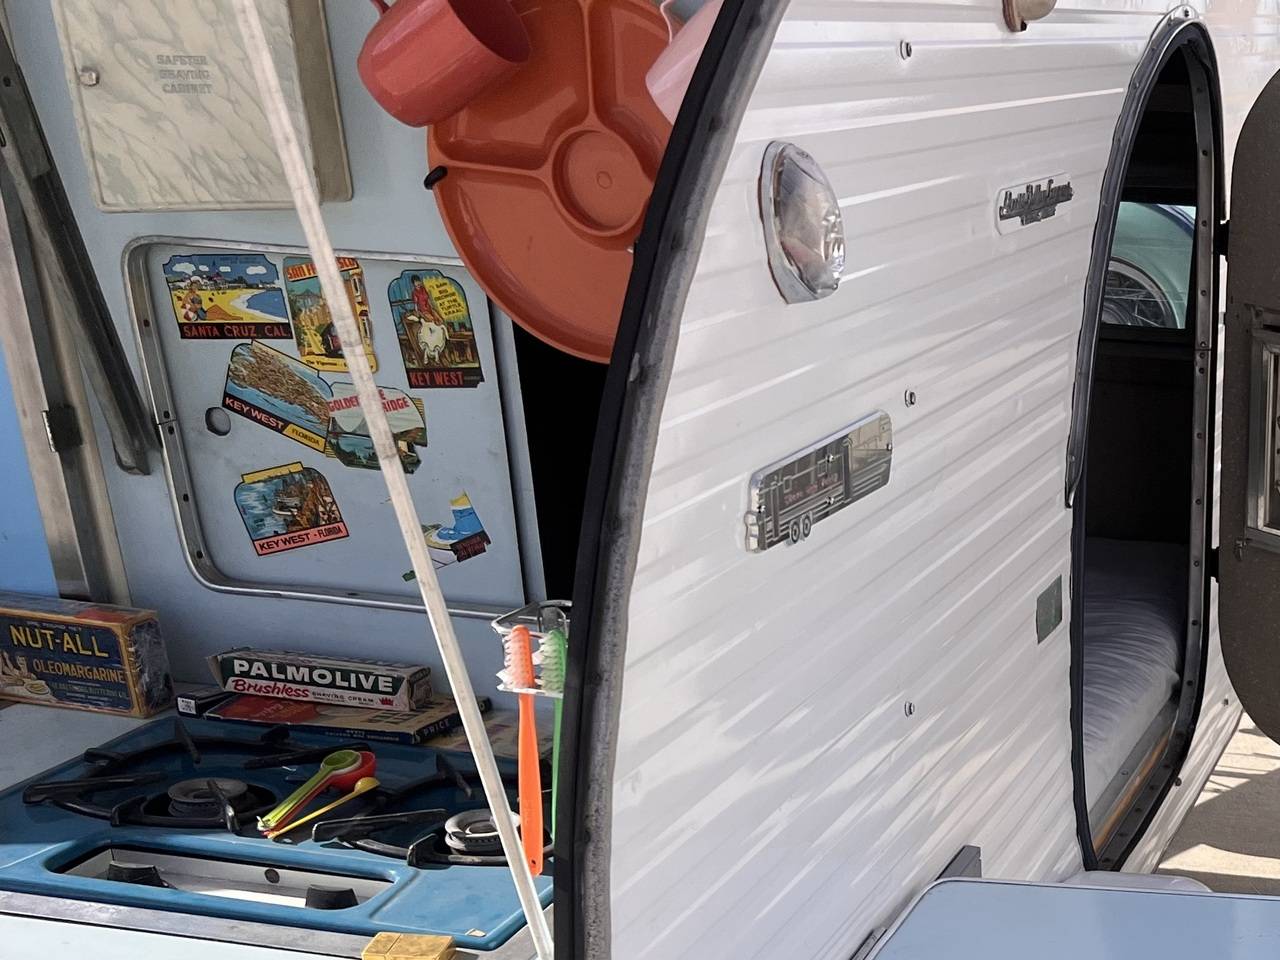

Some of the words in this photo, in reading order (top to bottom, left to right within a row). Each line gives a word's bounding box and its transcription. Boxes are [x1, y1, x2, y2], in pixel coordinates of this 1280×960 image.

[183, 325, 219, 337] SANTA
[224, 325, 256, 337] CRUZ
[264, 325, 291, 337] CAL.
[409, 371, 431, 386] KEY
[434, 371, 464, 386] WEST
[225, 397, 250, 414] KEY
[251, 409, 284, 430] WEST
[291, 428, 320, 446] FLORIDA
[258, 540, 280, 552] KEY
[280, 533, 310, 546] WEST
[317, 525, 343, 538] FLORIDA
[10, 625, 109, 657] NUT-ALL
[33, 658, 126, 683] OLEOMARGARINE
[233, 659, 393, 692] PALMOLIVE
[231, 679, 310, 698] Brushless
